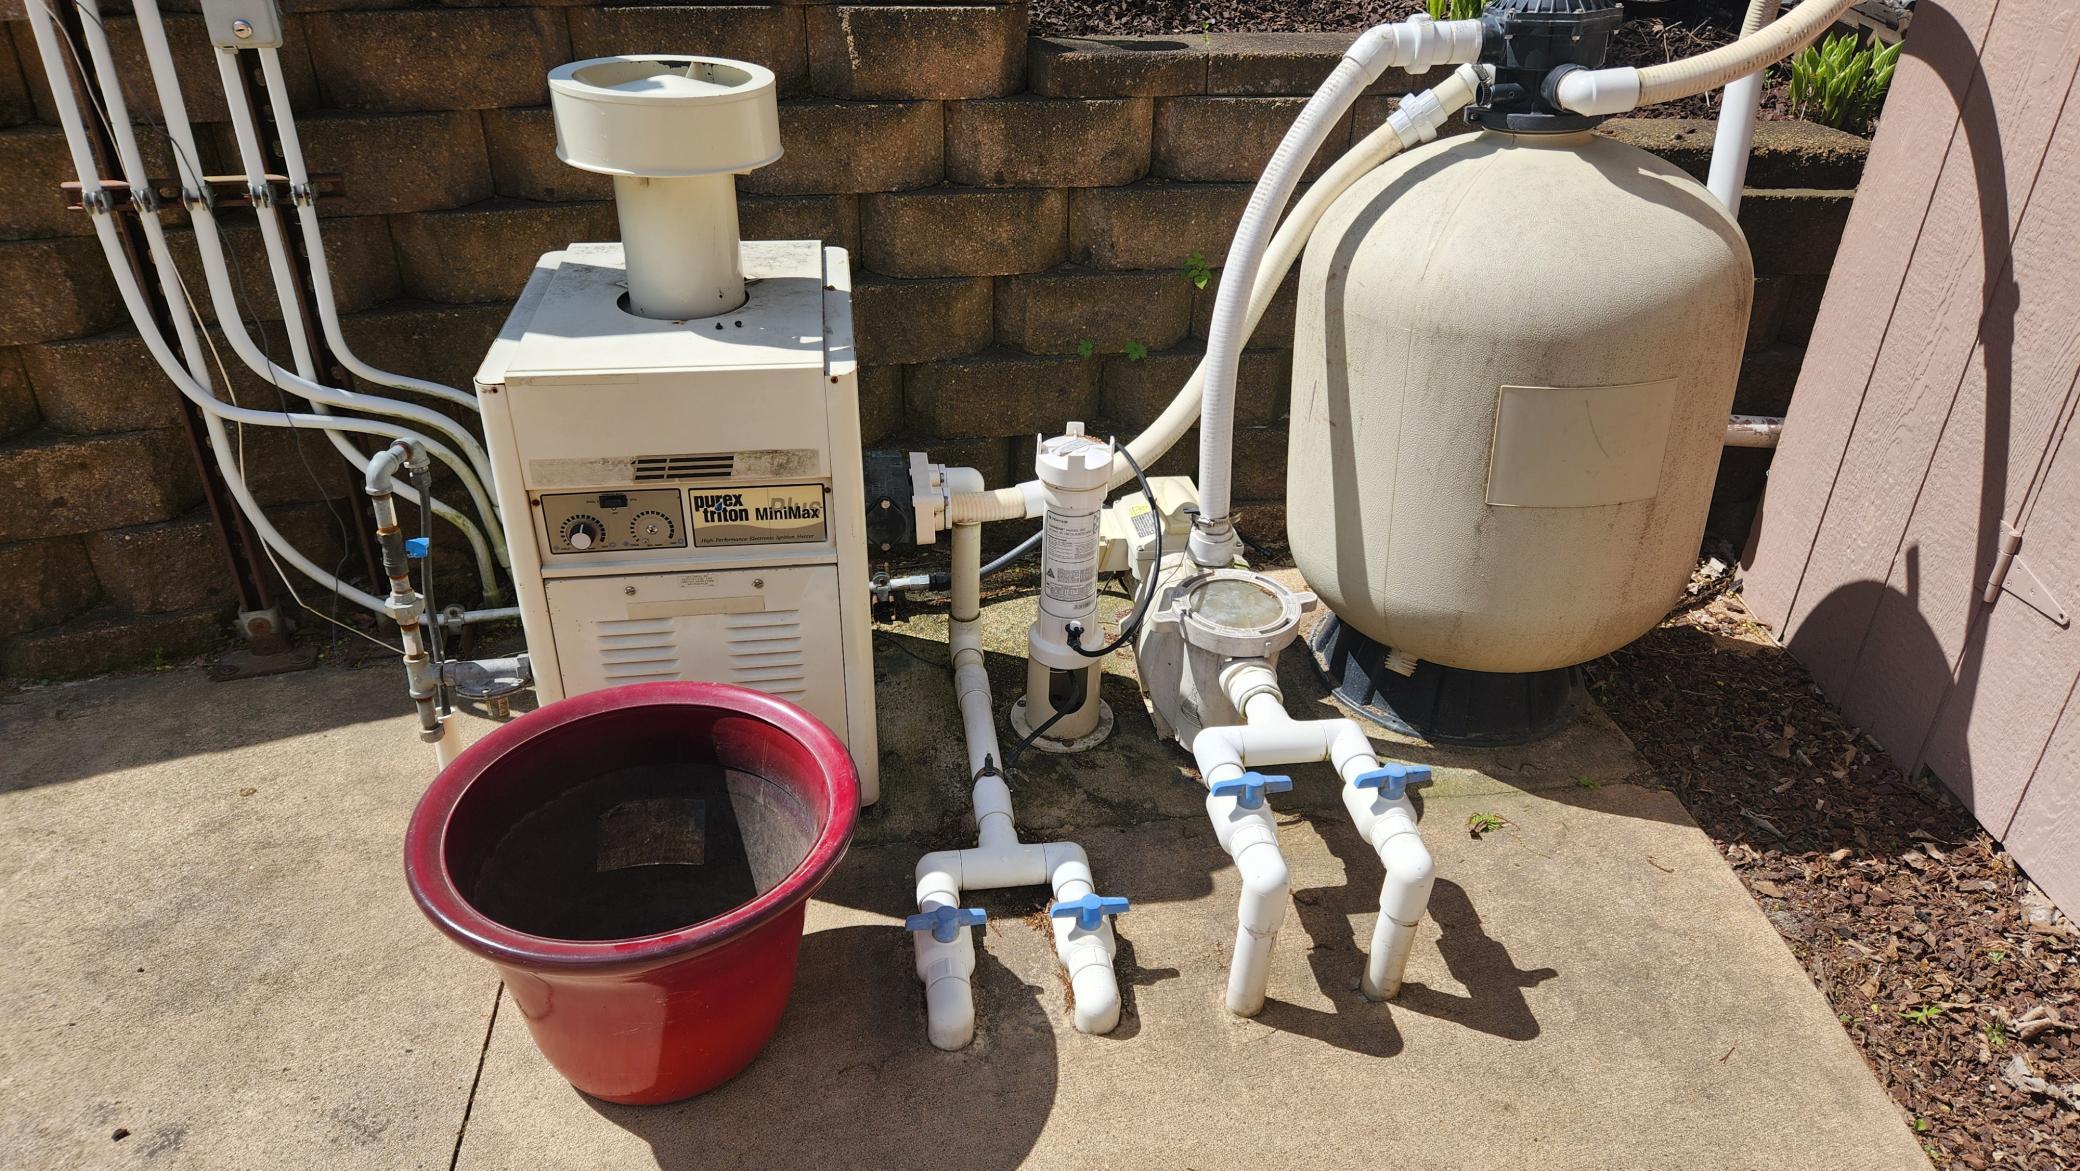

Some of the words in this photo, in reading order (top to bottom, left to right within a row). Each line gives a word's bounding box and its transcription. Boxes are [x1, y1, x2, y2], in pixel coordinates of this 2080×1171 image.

[693, 494, 744, 511] purex
[703, 508, 749, 522] triton
[755, 506, 820, 520] MiniMax
